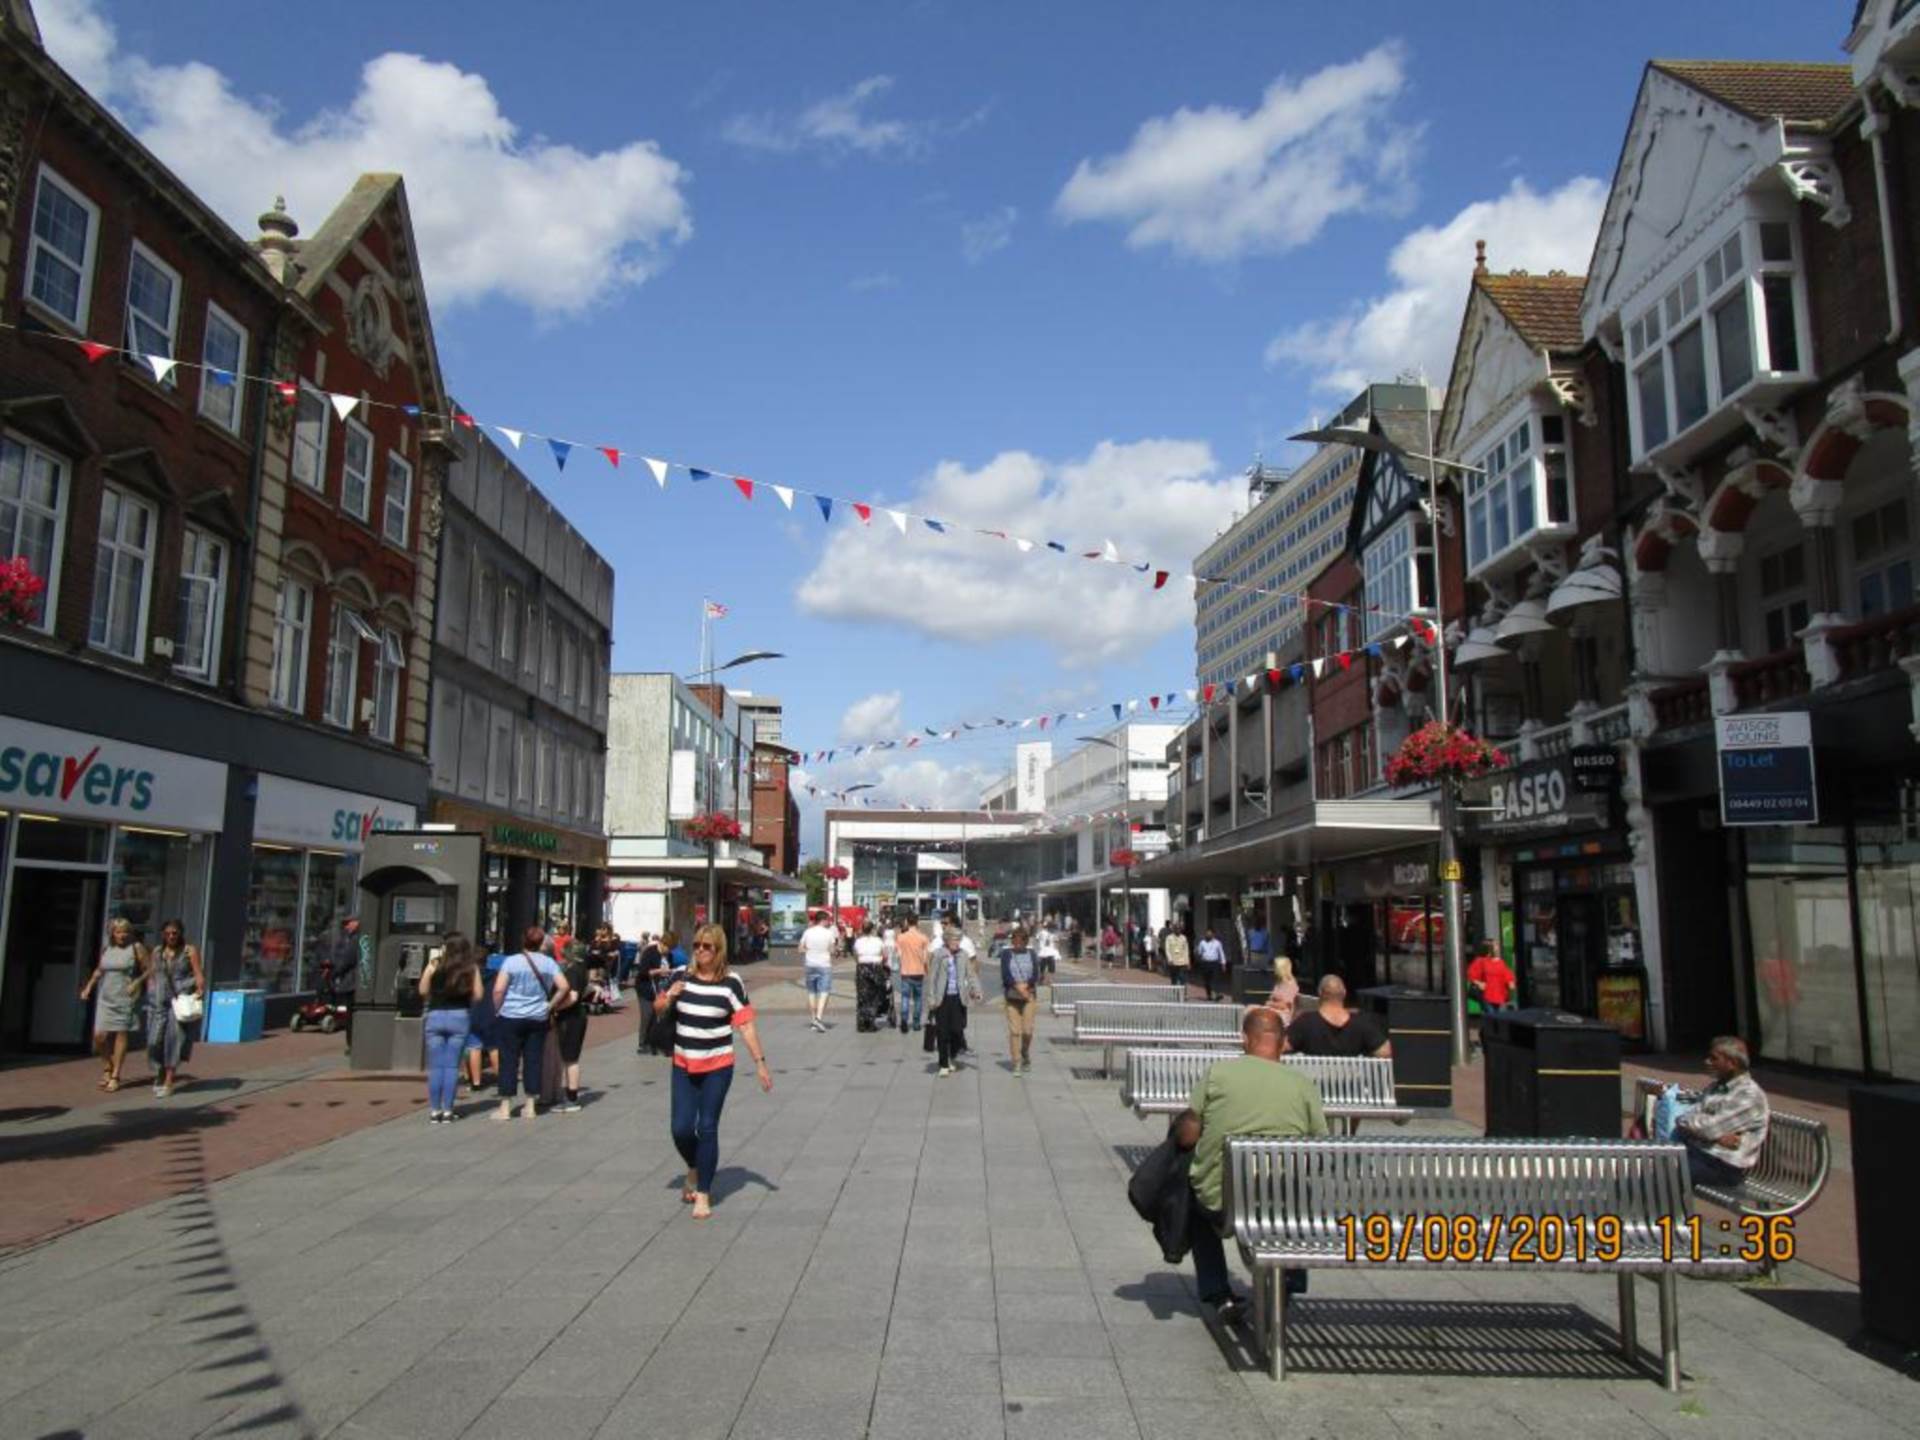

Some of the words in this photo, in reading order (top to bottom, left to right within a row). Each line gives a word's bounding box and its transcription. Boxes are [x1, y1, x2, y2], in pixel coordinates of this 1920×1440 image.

[1725, 720, 1780, 732] AVISON
[1726, 731, 1780, 743] YOUNG
[1574, 754, 1615, 767] BASEO
[1725, 754, 1746, 768] To
[1750, 752, 1775, 768] Let
[0, 746, 154, 811] savers
[1490, 769, 1565, 822] BASEO
